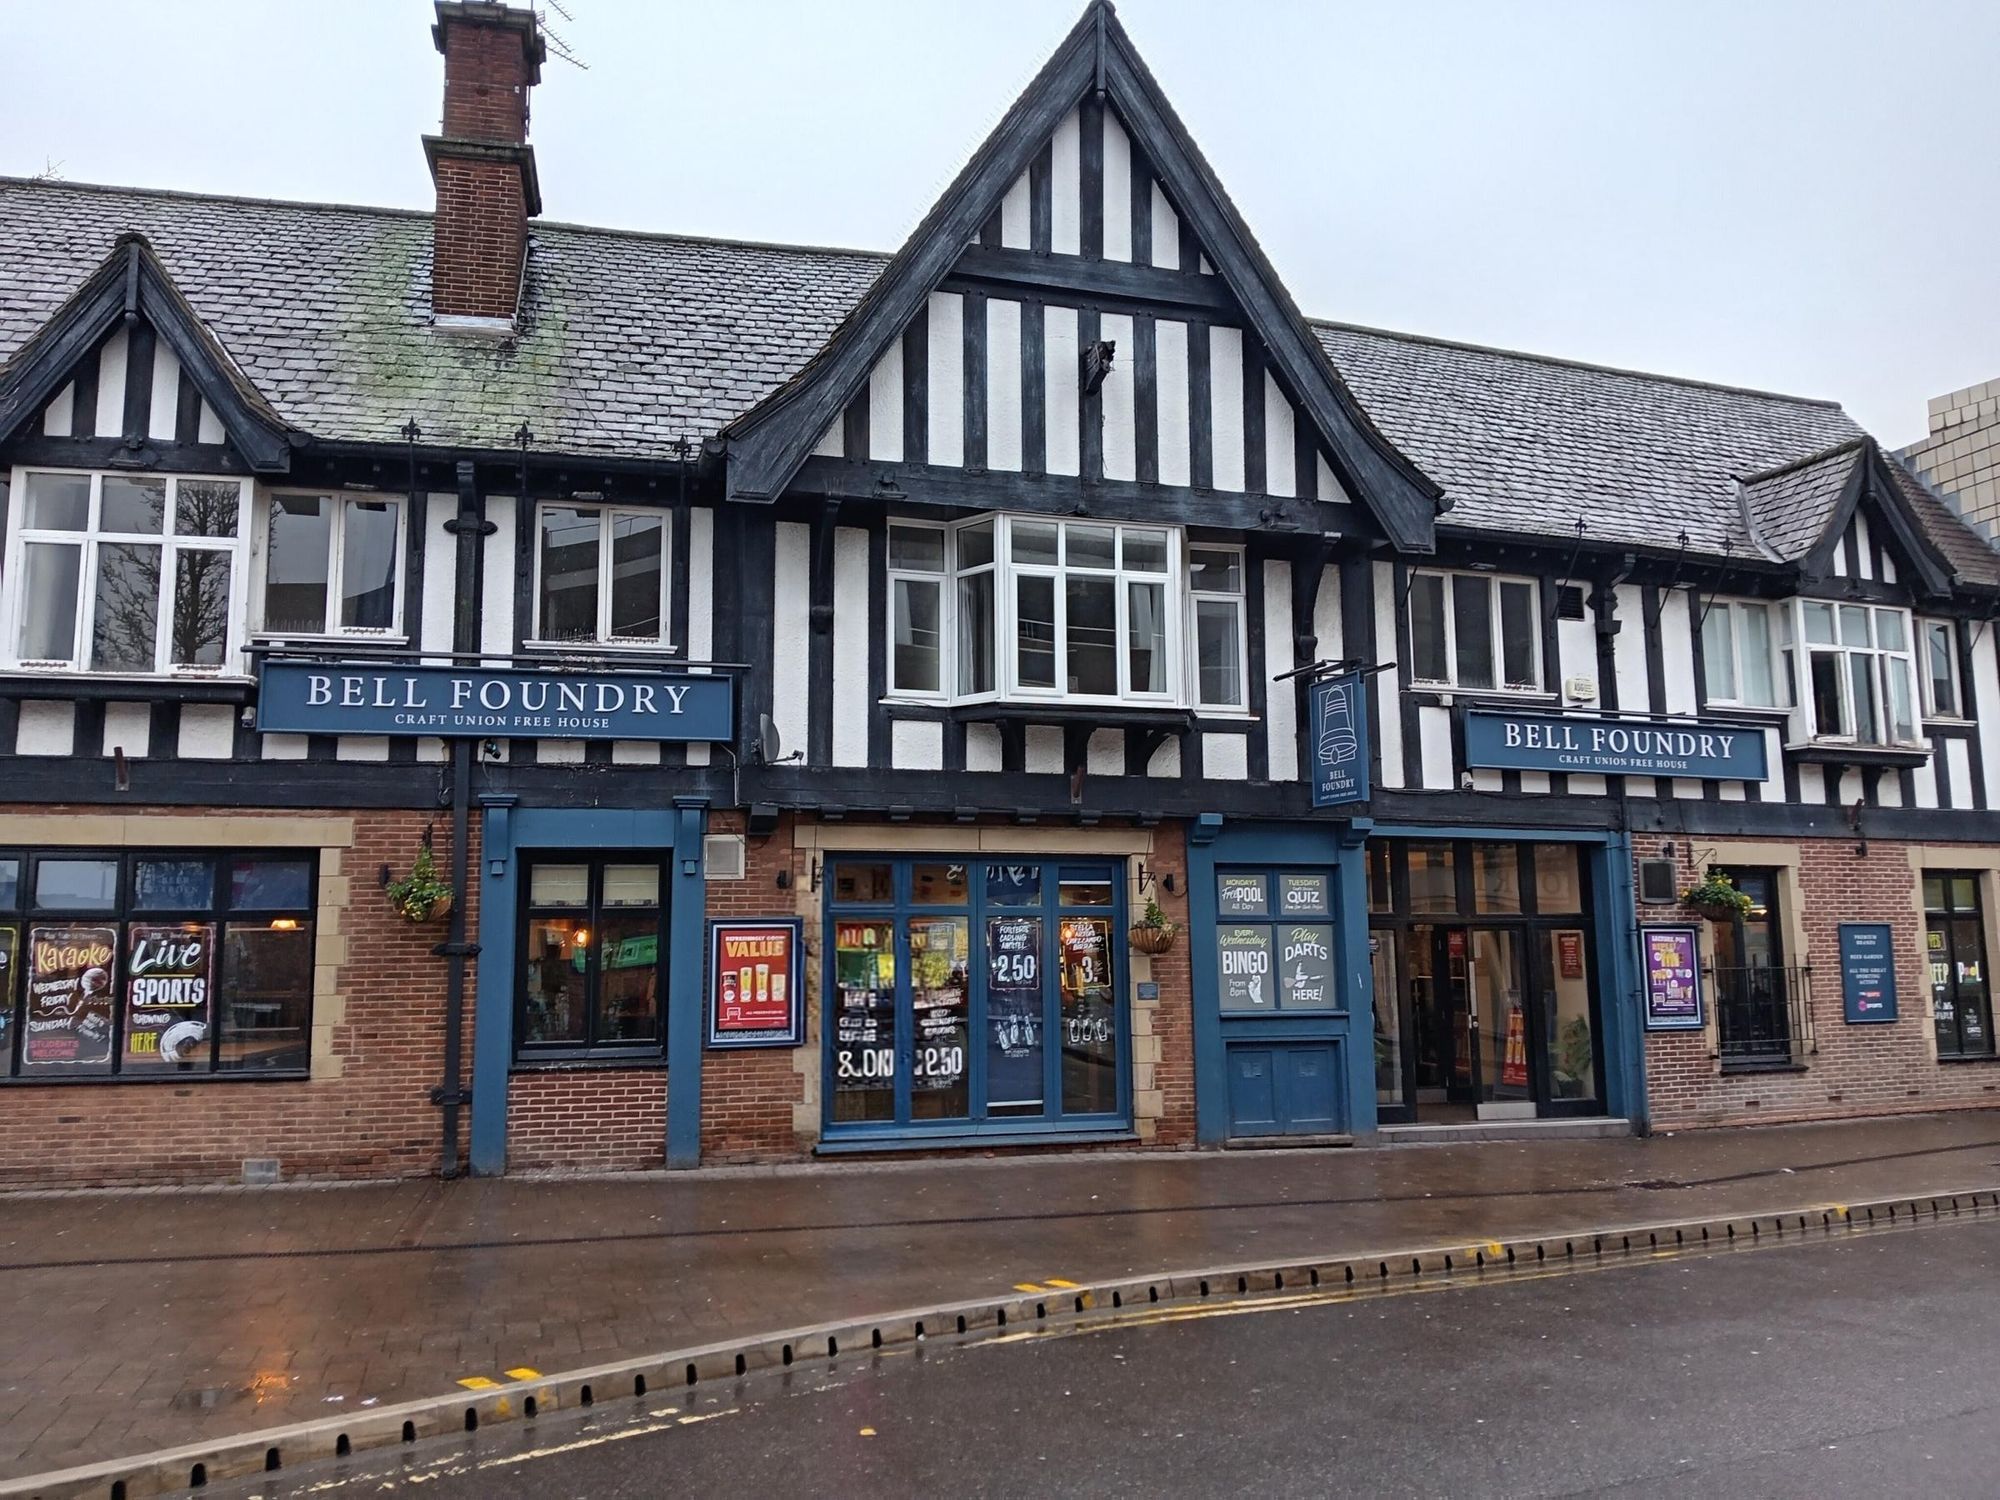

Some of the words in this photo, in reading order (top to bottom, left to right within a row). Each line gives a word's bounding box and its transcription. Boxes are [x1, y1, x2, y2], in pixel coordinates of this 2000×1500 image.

[306, 674, 427, 707] BELL
[449, 679, 692, 715] FOUNDRY
[394, 712, 446, 726] CRAFT
[454, 714, 507, 727] UNION
[513, 715, 552, 728] FREE
[557, 716, 610, 729] HOUSE
[1504, 722, 1579, 751] BELL
[1590, 727, 1736, 759] FOUNDRY
[1558, 754, 1591, 765] CRAFT
[1594, 756, 1628, 767] UNION
[1630, 758, 1654, 768] FREE
[1656, 759, 1688, 770] HOUSE
[1329, 769, 1346, 780] BELL
[1321, 778, 1355, 792] FOUNDRY
[1288, 879, 1320, 887] TUESDAYS
[1237, 887, 1264, 902] POOL
[1287, 891, 1320, 904] QUIZ
[1242, 902, 1254, 911] Day
[1219, 934, 1268, 948] Wednesday
[1290, 927, 1320, 943] Play
[130, 939, 201, 974] Live
[725, 941, 785, 957] VALUE
[1284, 942, 1328, 962] DARTS
[36, 941, 113, 974] Karaoke
[1222, 950, 1268, 975] BINGO
[132, 977, 205, 1006] SPORTS
[1229, 979, 1246, 988] From
[1229, 987, 1247, 998] 8pm
[1292, 985, 1324, 1001] HERE!
[29, 1017, 74, 1032] SUNDAY
[132, 1013, 171, 1024] SHOWING
[130, 1032, 157, 1054] HERE
